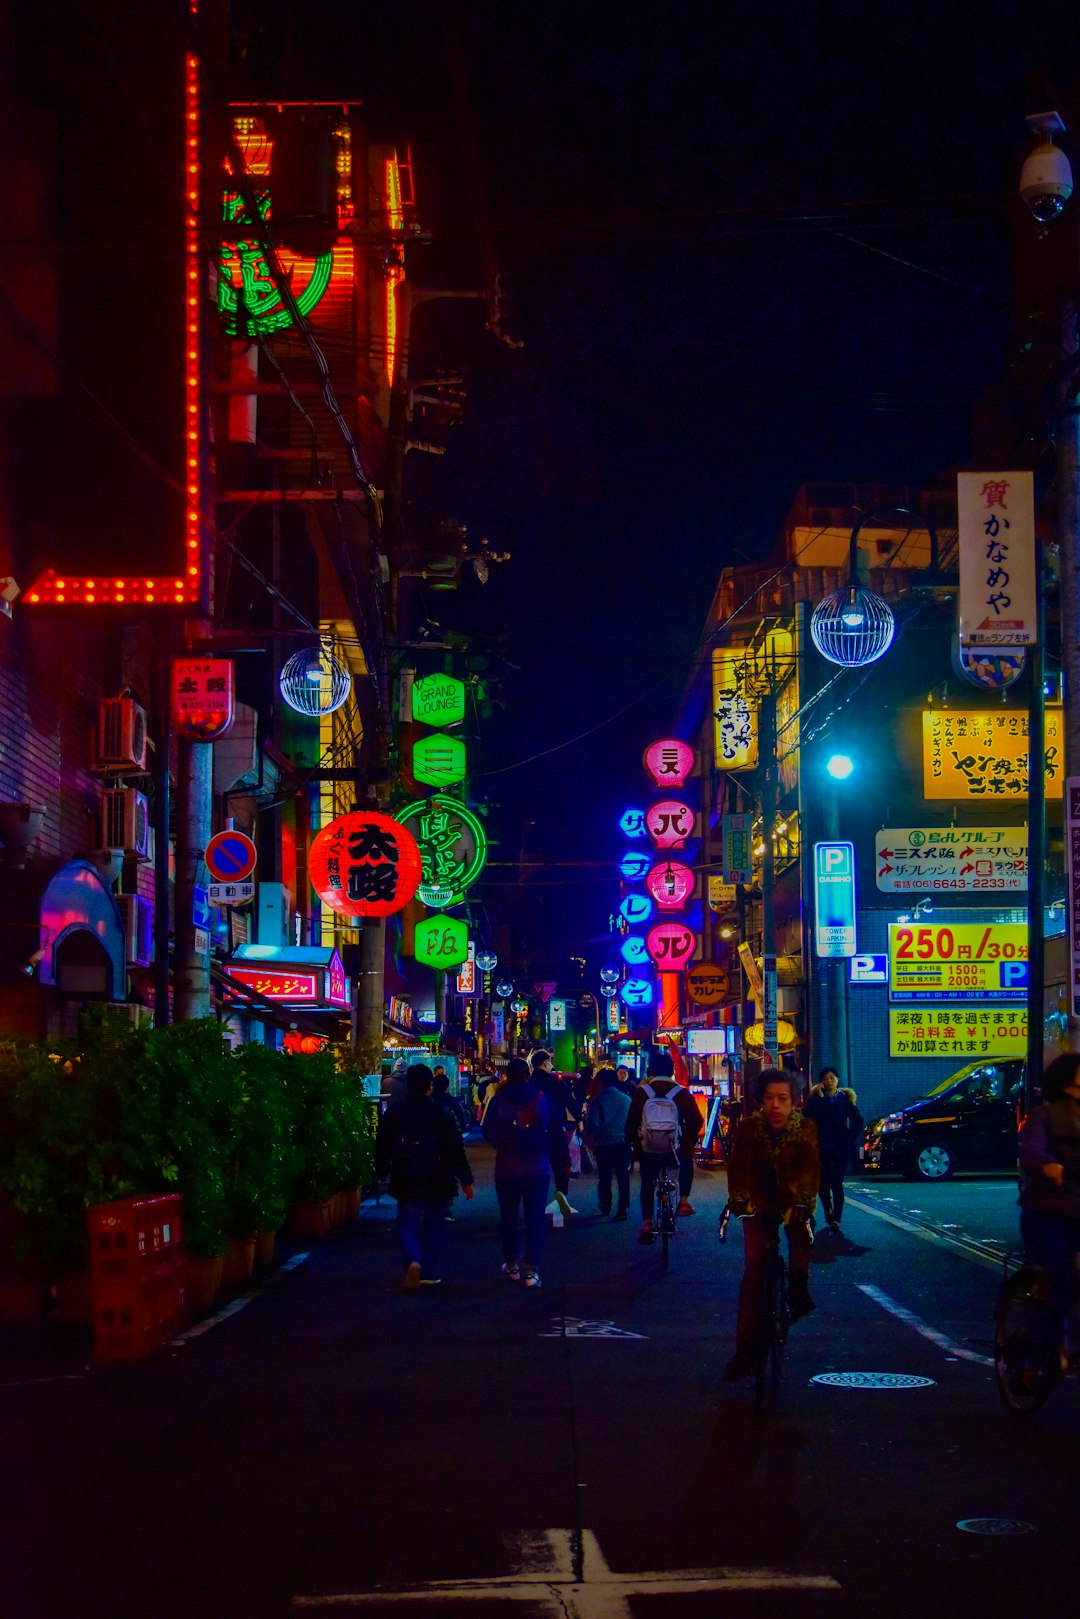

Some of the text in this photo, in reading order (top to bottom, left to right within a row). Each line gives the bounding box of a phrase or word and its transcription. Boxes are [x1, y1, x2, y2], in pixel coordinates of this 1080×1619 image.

[983, 514, 1012, 615] かなめや
[421, 685, 456, 702] GRAND
[417, 695, 460, 716] LOUNGE
[932, 717, 942, 777] ジンギスカン
[825, 849, 843, 872] P
[209, 886, 252, 897] 自動車
[851, 957, 875, 980] P
[1004, 962, 1026, 986] P
[694, 986, 725, 996] カレー
[896, 1026, 956, 1038] 一泊料金
[897, 1040, 991, 1052] が加算されます
